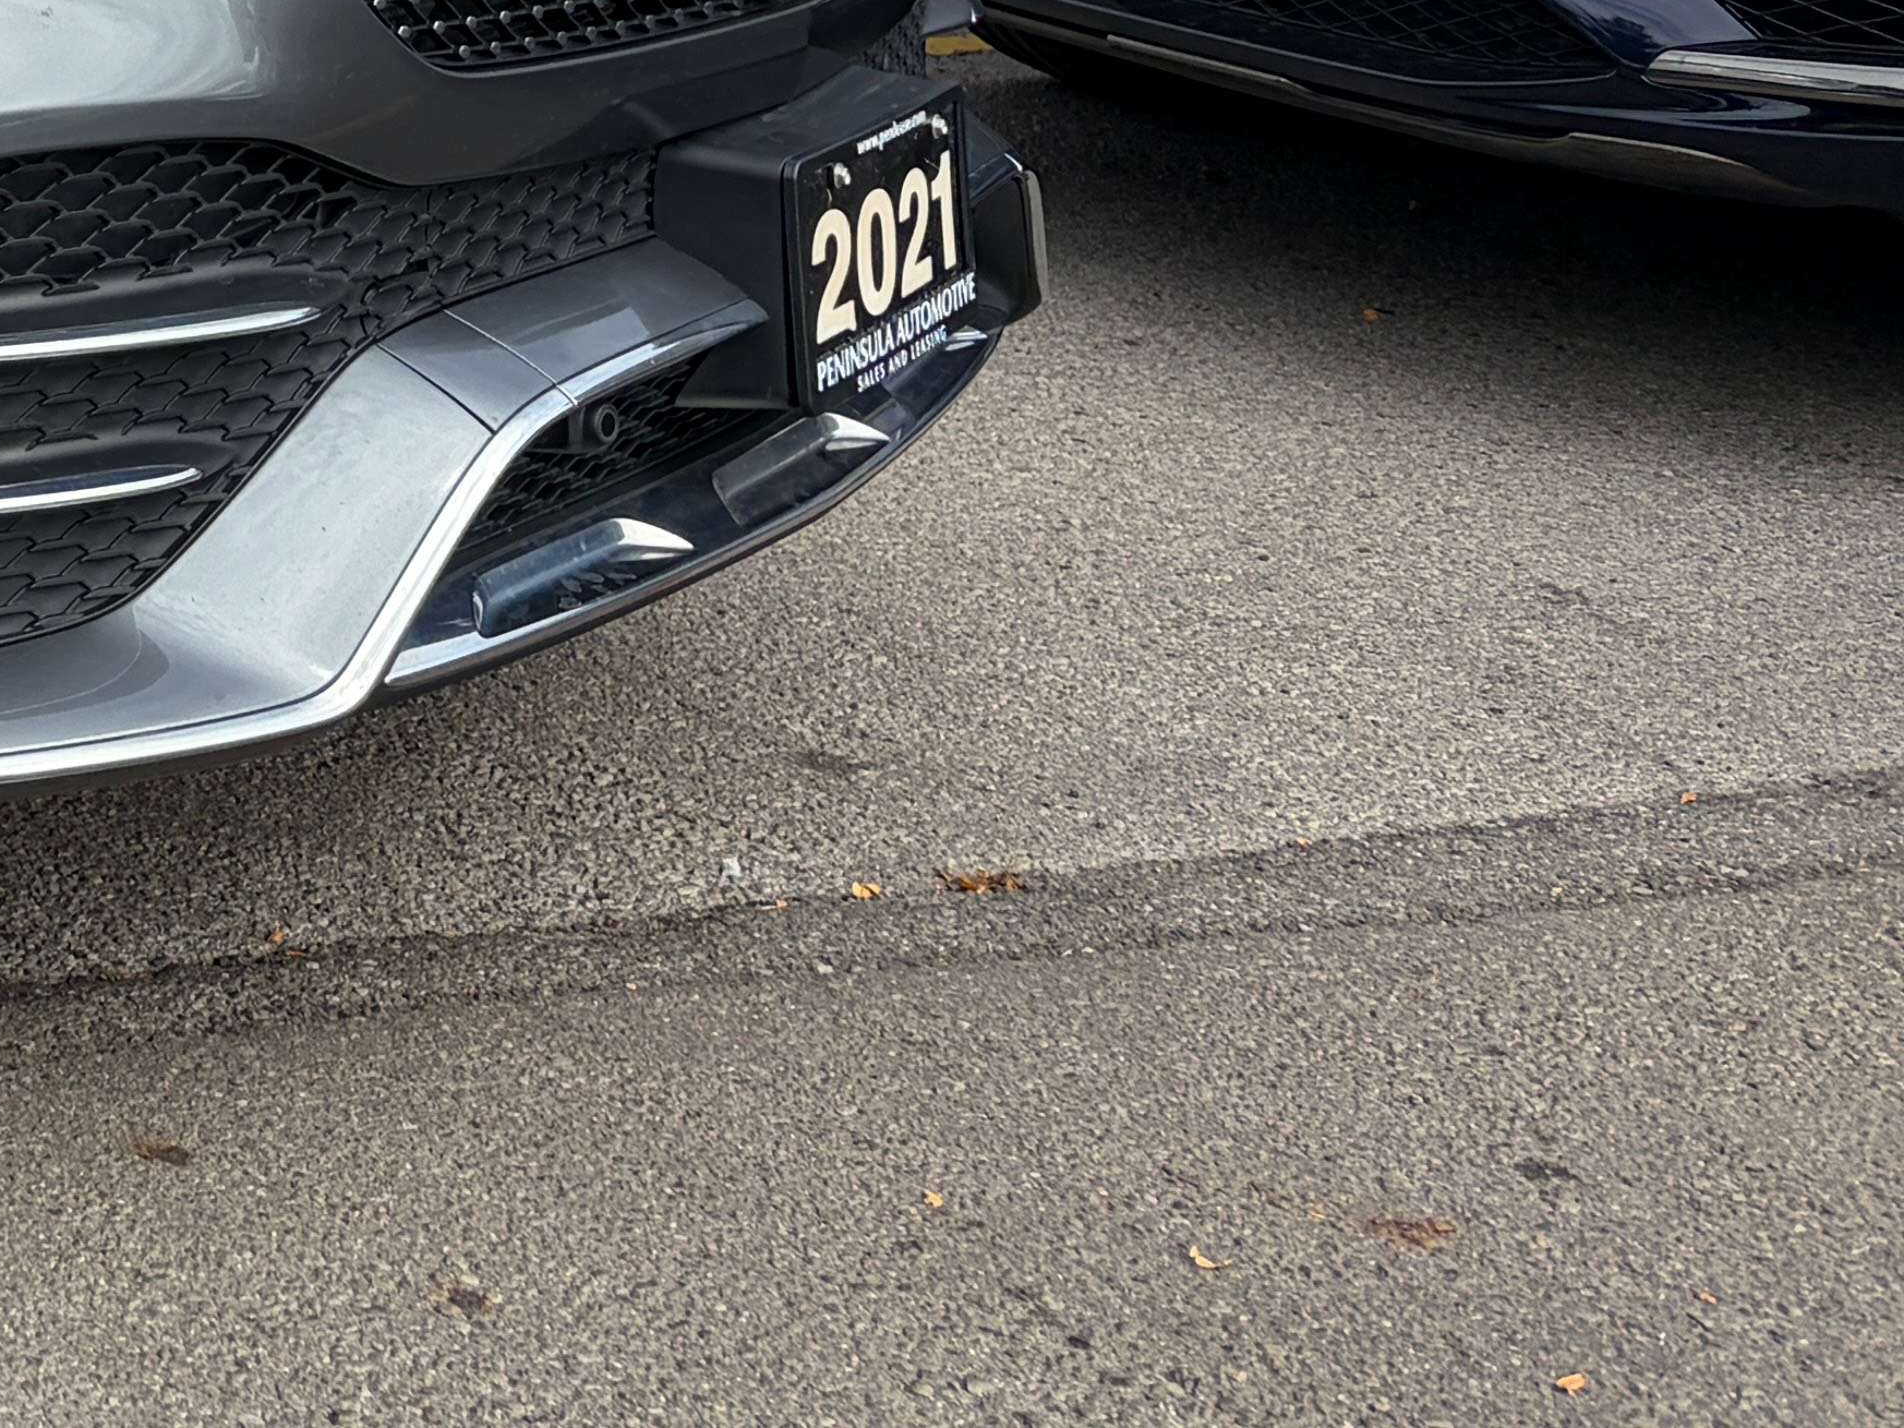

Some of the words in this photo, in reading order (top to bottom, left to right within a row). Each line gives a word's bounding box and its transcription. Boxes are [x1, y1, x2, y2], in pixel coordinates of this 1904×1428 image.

[811, 149, 958, 345] 2021
[816, 322, 895, 393] PENINSULA
[896, 271, 977, 345] AUTOMOTIVE
[856, 361, 887, 393] SALES
[888, 348, 909, 374] AND
[909, 324, 948, 361] LEASING
